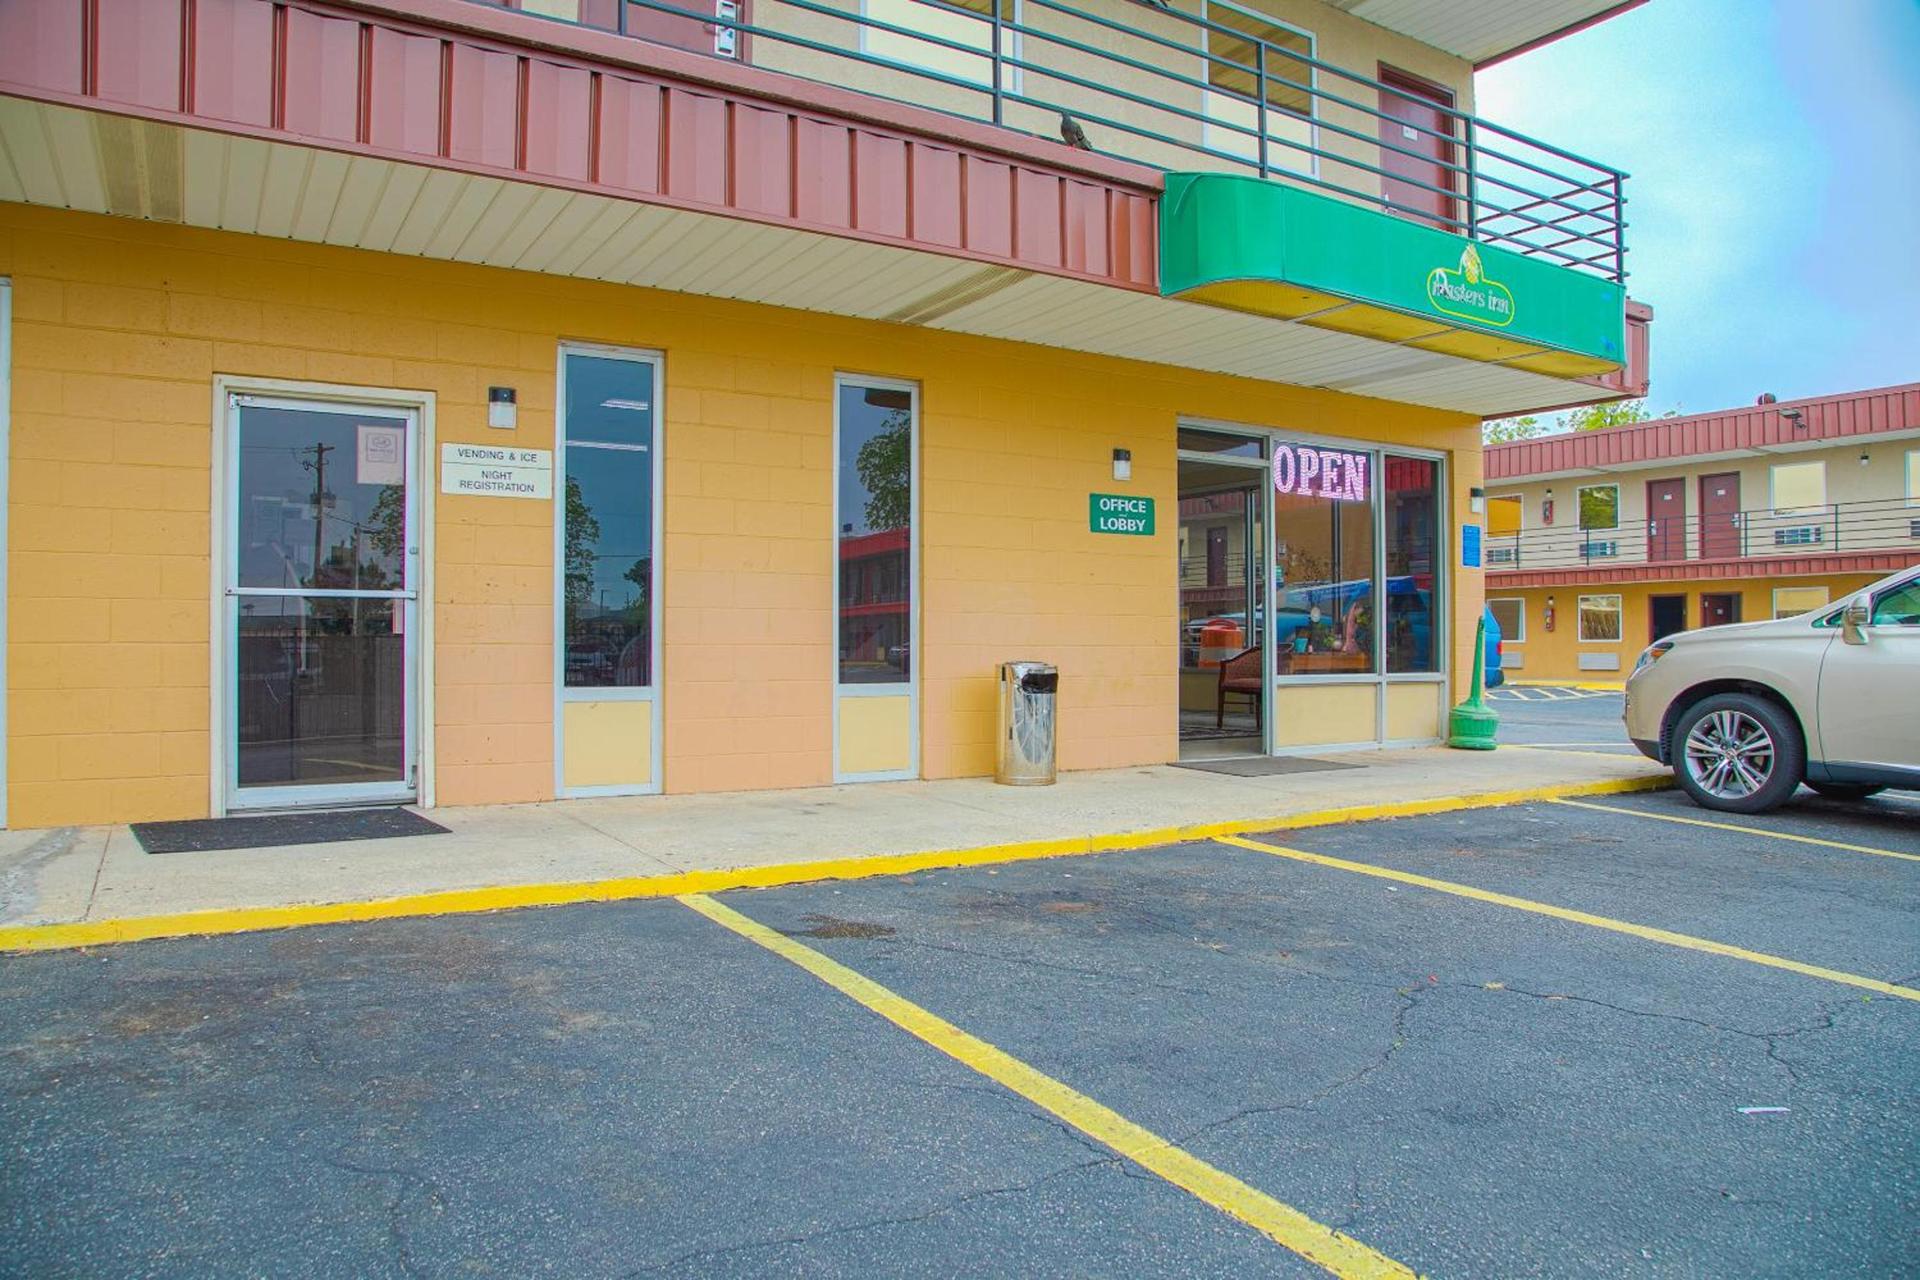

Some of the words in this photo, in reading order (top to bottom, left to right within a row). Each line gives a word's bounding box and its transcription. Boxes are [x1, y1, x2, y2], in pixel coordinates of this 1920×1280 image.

[458, 448, 504, 460] VENDING
[508, 452, 516, 461] &
[520, 453, 537, 463] ICE
[481, 470, 513, 481] NIGHT
[1273, 445, 1367, 502] OPEN
[459, 480, 535, 492] REGISTRATION
[1099, 498, 1147, 513] OFFICE
[1100, 516, 1146, 532] LOBBY
